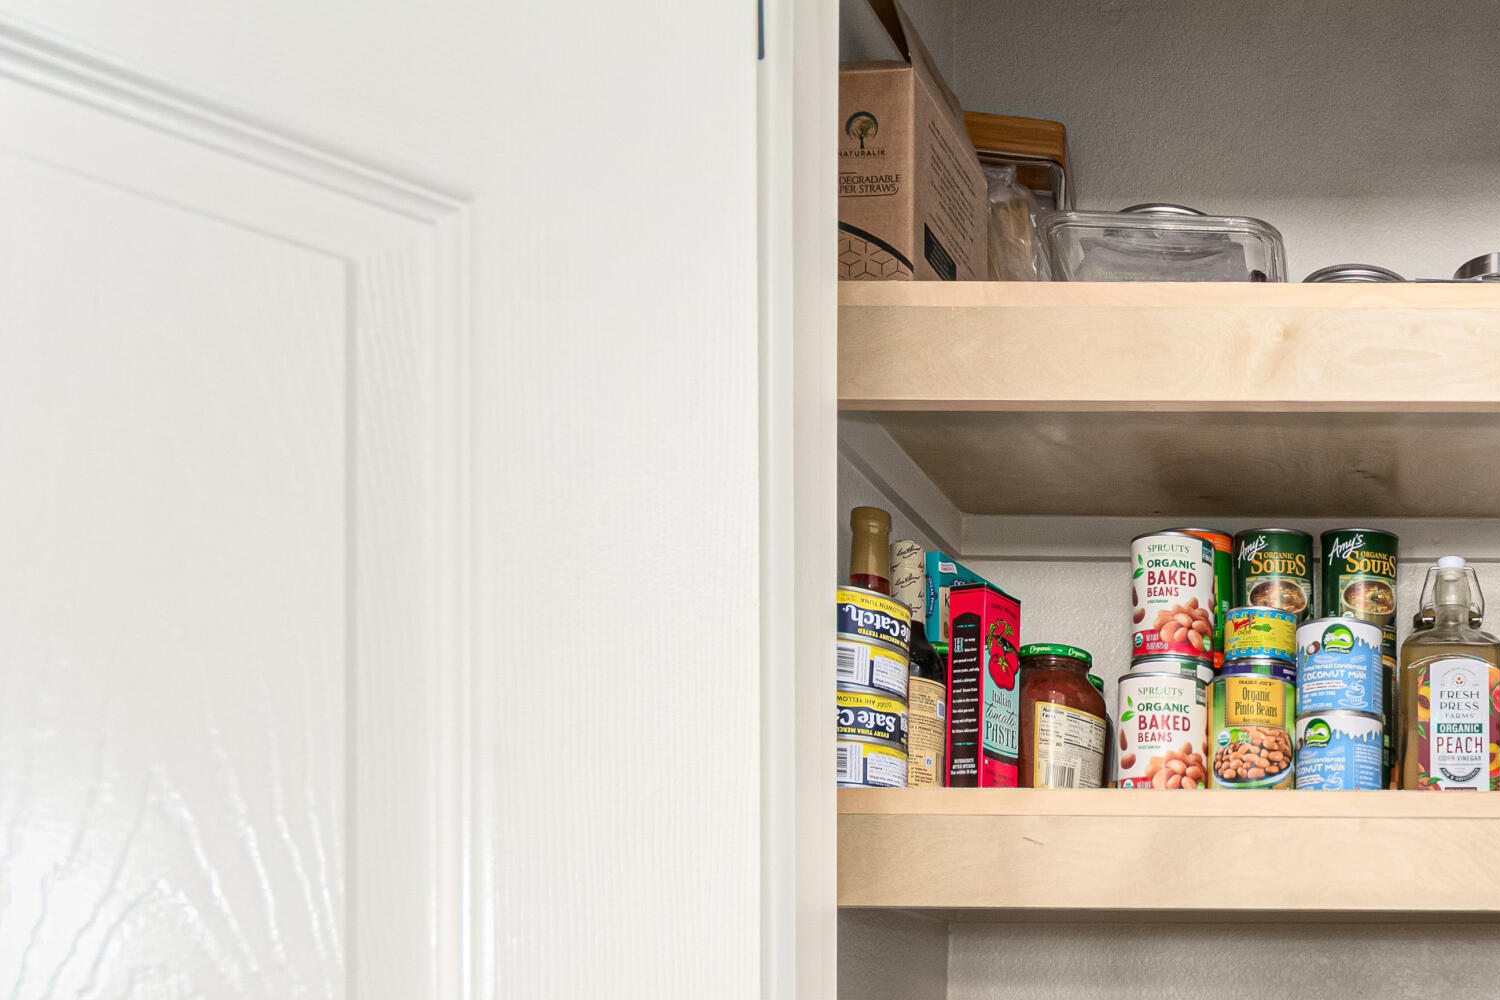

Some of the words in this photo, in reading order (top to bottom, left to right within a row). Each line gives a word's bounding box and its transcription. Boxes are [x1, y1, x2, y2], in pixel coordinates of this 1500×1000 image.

[858, 184, 896, 193] STRAWS
[1148, 544, 1190, 553] SPROUTS
[1238, 535, 1268, 569] Amy's
[1328, 534, 1366, 566] Amy's
[1361, 551, 1388, 560] ORGANIC
[1147, 559, 1196, 570] ORGANIC
[1148, 570, 1196, 587] BAKED
[1147, 587, 1179, 597] BEANS
[846, 604, 900, 636] Catch
[1303, 670, 1346, 681] COCONUT
[1138, 687, 1183, 696] SPROUTS
[1242, 687, 1270, 702] Organic
[1440, 691, 1480, 699] FRESH
[992, 690, 1012, 709] Italian
[1138, 703, 1190, 713] ORGANIC
[1235, 702, 1255, 716] Pinto
[1256, 703, 1278, 717] Beans
[1440, 702, 1480, 710] PRESS
[857, 710, 896, 732] Safe
[1138, 714, 1191, 732] BAKED
[1440, 724, 1480, 733] ORGANIC
[986, 720, 1017, 750] PASTE
[1138, 732, 1172, 743] BEANS
[1437, 737, 1483, 753] PEACH
